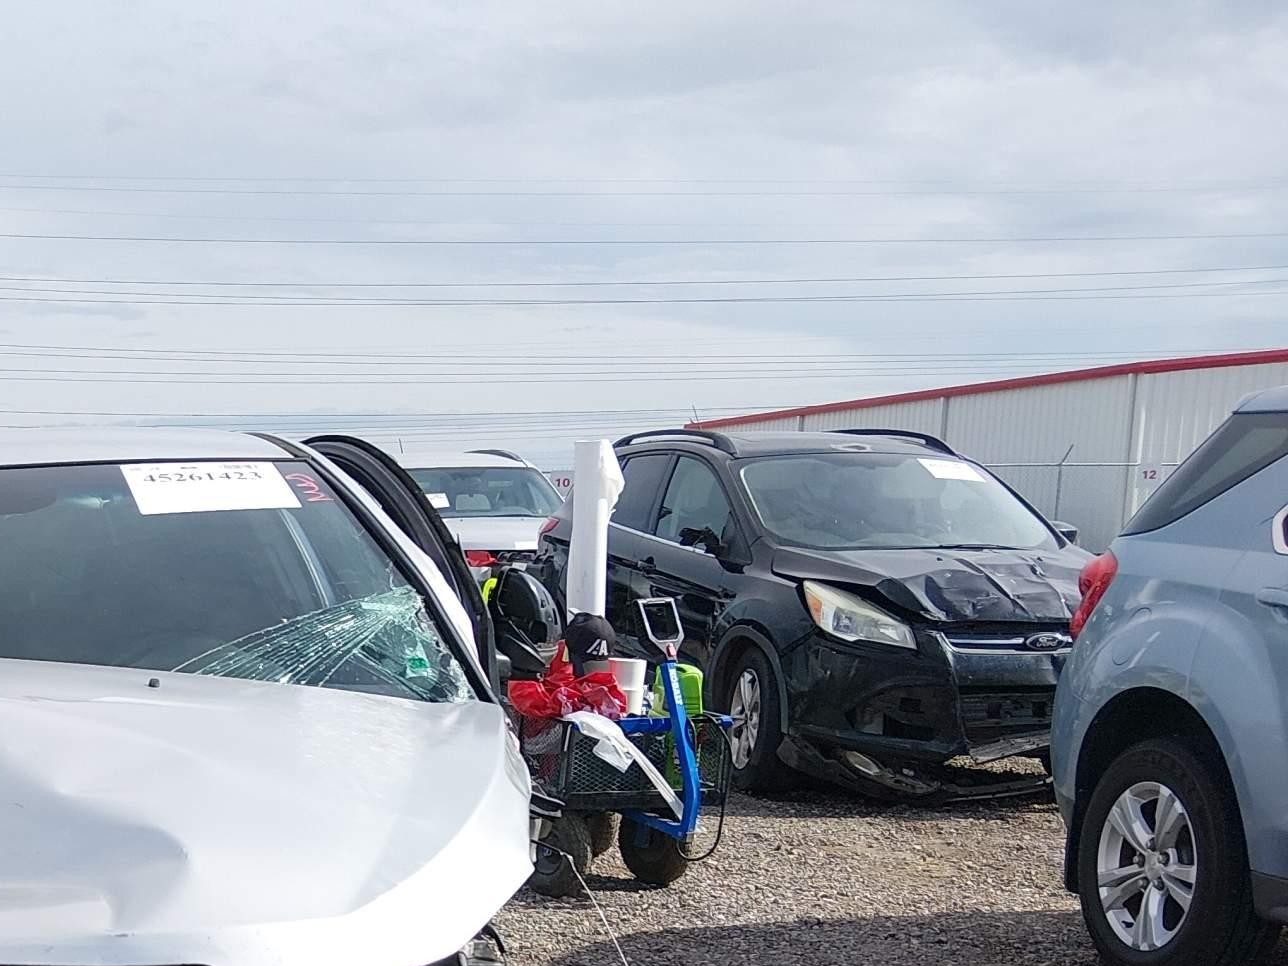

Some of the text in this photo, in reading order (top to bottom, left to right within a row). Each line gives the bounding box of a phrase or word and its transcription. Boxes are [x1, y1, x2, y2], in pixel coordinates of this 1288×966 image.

[143, 471, 263, 483] 45261423
[1142, 470, 1157, 480] 12
[555, 478, 571, 488] 10
